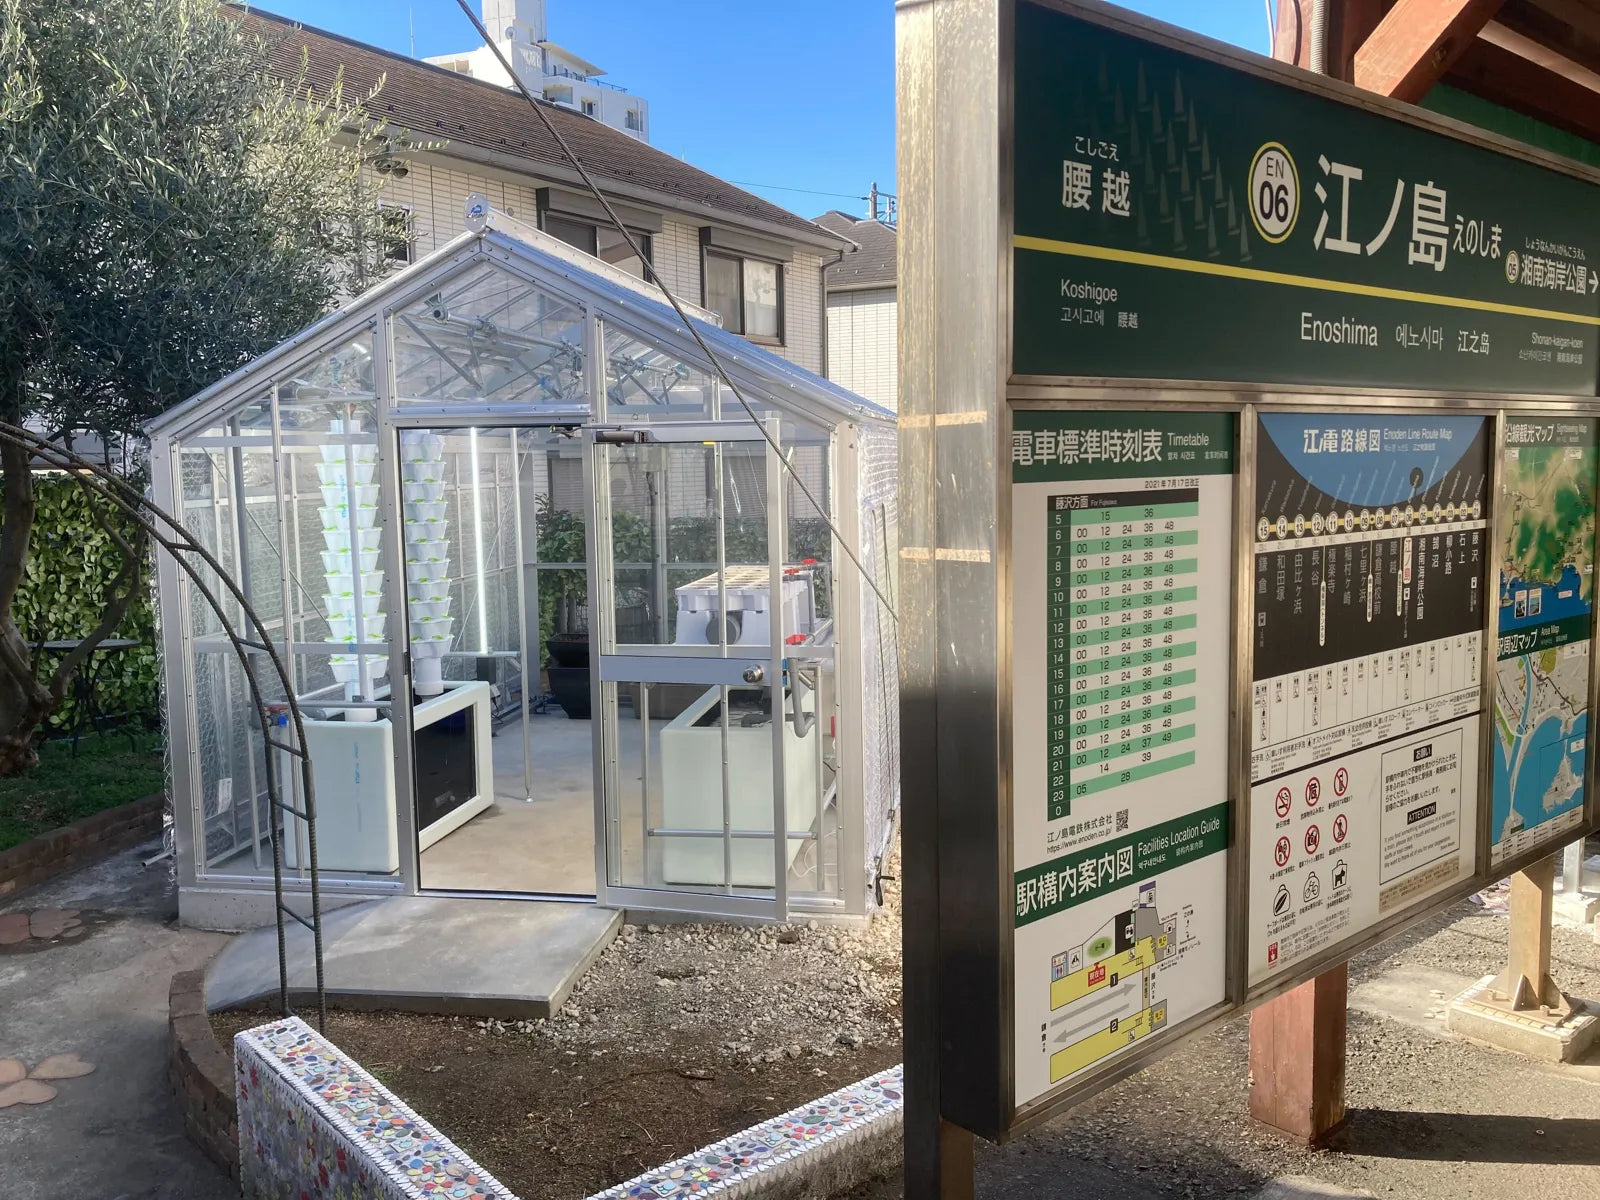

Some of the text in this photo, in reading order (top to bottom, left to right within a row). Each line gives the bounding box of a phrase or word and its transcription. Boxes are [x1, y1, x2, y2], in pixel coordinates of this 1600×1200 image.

[1075, 136, 1119, 161] こしごえ
[1266, 157, 1284, 178] EN
[1062, 160, 1130, 216] 腰越
[1259, 184, 1289, 222] 06
[1313, 154, 1448, 272] 江ノ島
[1452, 213, 1502, 259] えのしま
[1508, 264, 1516, 276] 05
[1521, 254, 1587, 295] 湘南海岸公園
[1061, 279, 1118, 304] Koshigoe
[1060, 307, 1104, 326] 고시고에
[1300, 311, 1378, 348] Enoshima
[1395, 322, 1444, 352] 에노시마
[1457, 329, 1490, 356] 江之岛
[1168, 432, 1210, 446] Timetable
[1384, 428, 1407, 440] Enoden
[1408, 428, 1420, 440] Line
[1012, 429, 1162, 466] 電車標準時刻表
[1055, 508, 1153, 524] 5 15 36
[1260, 524, 1268, 533] 15
[1313, 522, 1320, 530] 12
[1055, 521, 1174, 540] 6 00 12 24 36 48
[1055, 535, 1174, 556] 7 00 12 24 36 48
[1459, 534, 1466, 564] 石上
[1055, 549, 1173, 571] 8 00 12 24 36 48
[1312, 550, 1320, 585] 長谷
[1055, 563, 1173, 587] 9 00 12 24 36 48
[1053, 577, 1173, 602] 10 00 12 24 36 48
[1053, 592, 1173, 617] 11 00 12 24 36 48
[1053, 606, 1173, 632] 12 00 12 24 36 48
[1053, 705, 1172, 740] 19 00 12 24 36 48
[1053, 719, 1172, 754] 20 00 12 24 36 48
[1053, 733, 1172, 770] 21 00 12 24 37 49
[1053, 752, 1151, 785] 22 14 39
[1053, 772, 1130, 800] 23 05 28
[1055, 806, 1062, 816] 0
[1408, 805, 1436, 823] ATTENTION
[1138, 836, 1168, 856] Facilities
[1171, 826, 1199, 846] Location
[1201, 817, 1220, 834] Guide
[1016, 846, 1134, 917] 駅構内案内図
